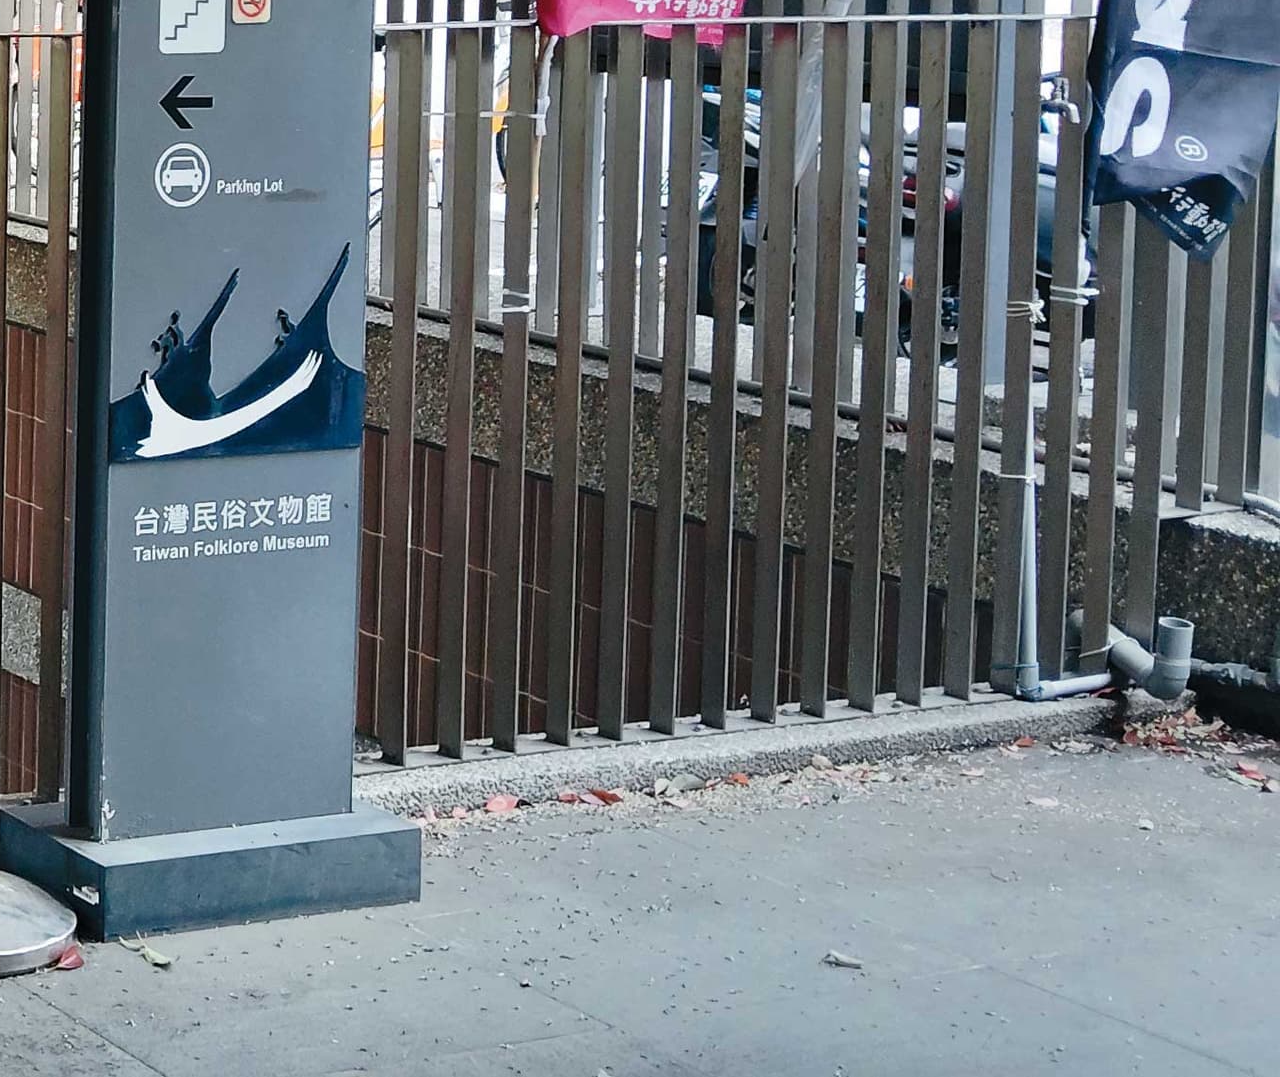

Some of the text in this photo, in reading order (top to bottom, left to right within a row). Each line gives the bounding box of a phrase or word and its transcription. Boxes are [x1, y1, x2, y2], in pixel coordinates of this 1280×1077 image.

[216, 178, 284, 196] Parking Lot
[134, 493, 333, 536] 台灣民俗文物館
[133, 533, 330, 563] Taiwan Folklore Museum
